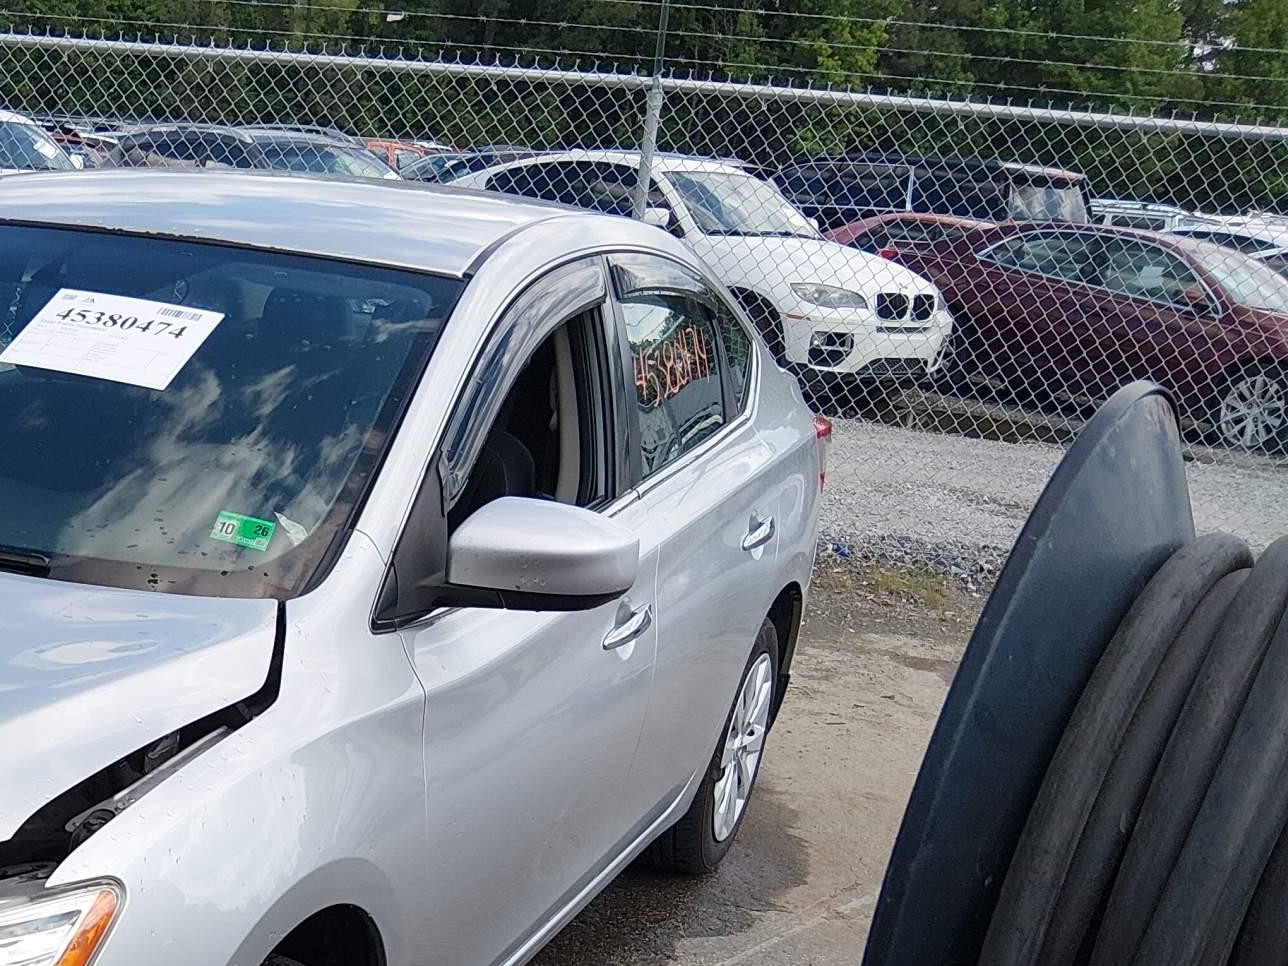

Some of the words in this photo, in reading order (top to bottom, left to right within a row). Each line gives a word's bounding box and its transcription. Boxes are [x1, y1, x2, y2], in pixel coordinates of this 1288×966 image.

[55, 306, 188, 340] 45380474
[218, 521, 236, 536] 10
[254, 524, 270, 538] 26
